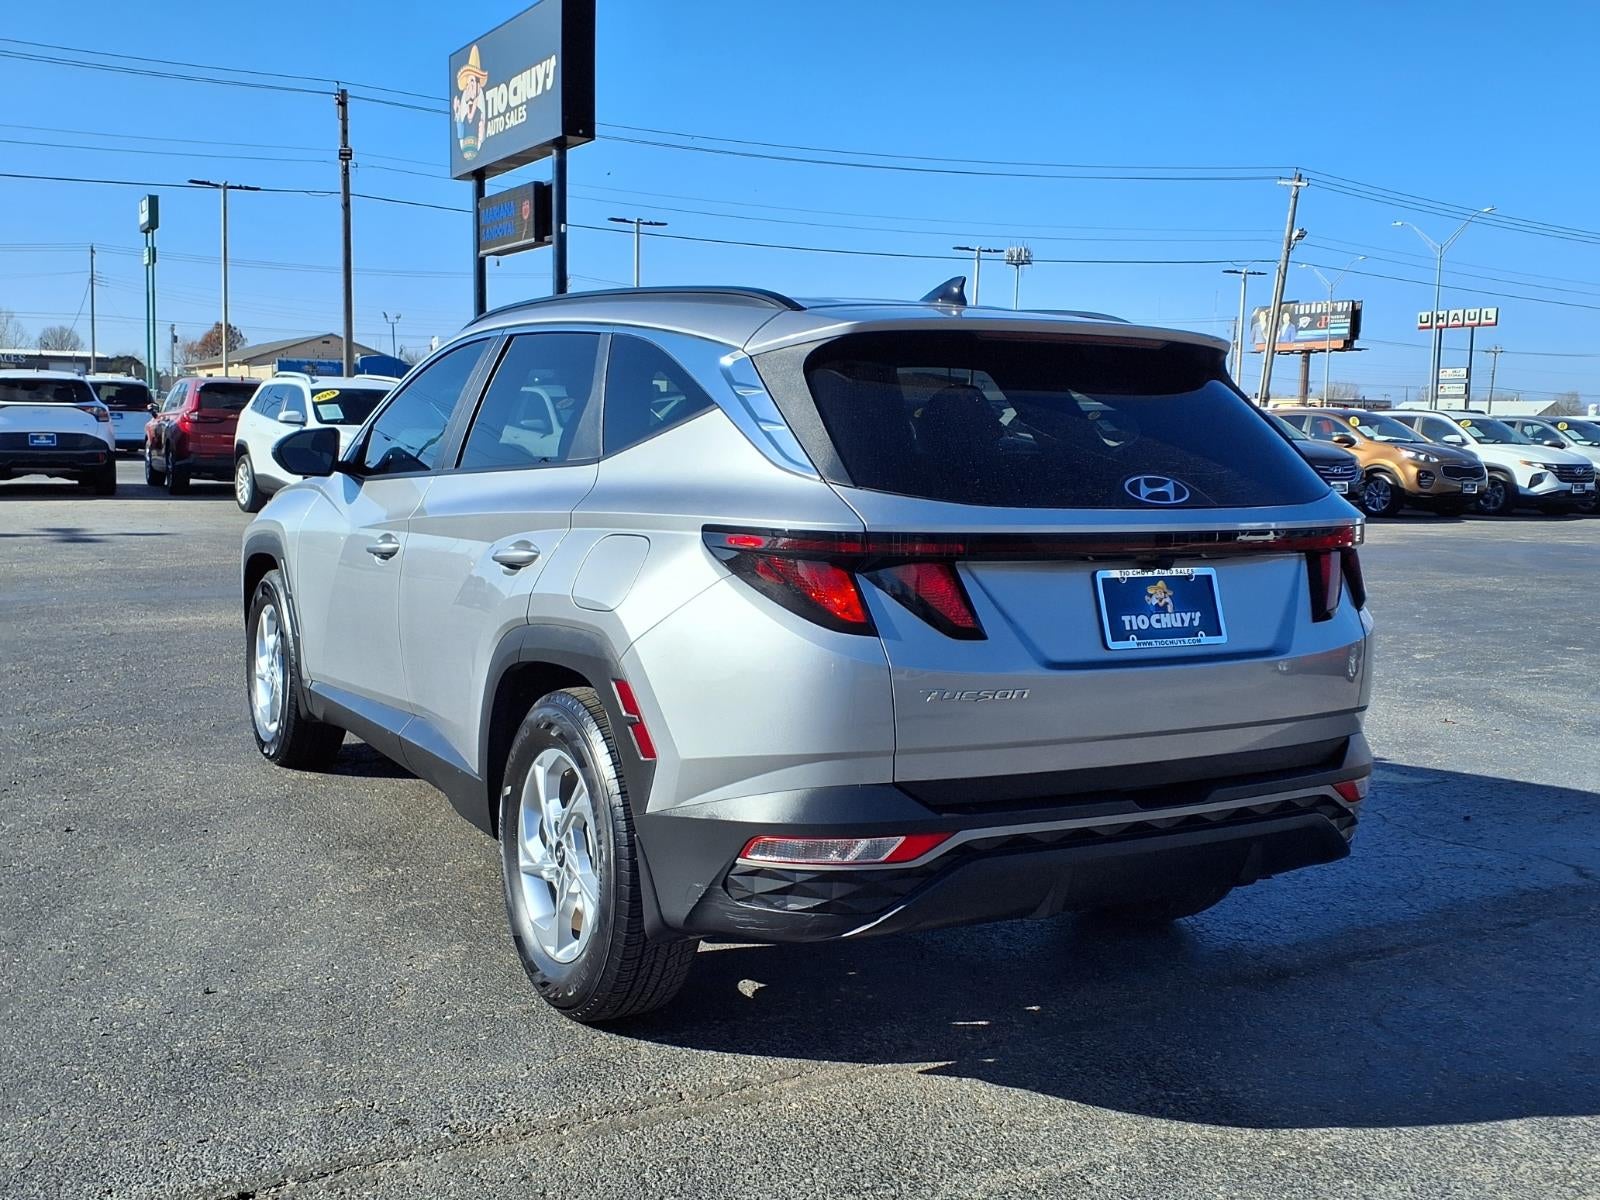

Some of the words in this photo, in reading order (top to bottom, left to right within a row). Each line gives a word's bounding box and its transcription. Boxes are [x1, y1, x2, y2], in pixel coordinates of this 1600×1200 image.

[486, 83, 507, 118] TIO
[508, 54, 556, 107] CHUY'S
[487, 116, 504, 137] AUTO
[505, 105, 527, 129] SALES
[1157, 568, 1174, 576] AUTO
[1121, 615, 1149, 630] TIO
[1150, 611, 1201, 628] CHUY'S
